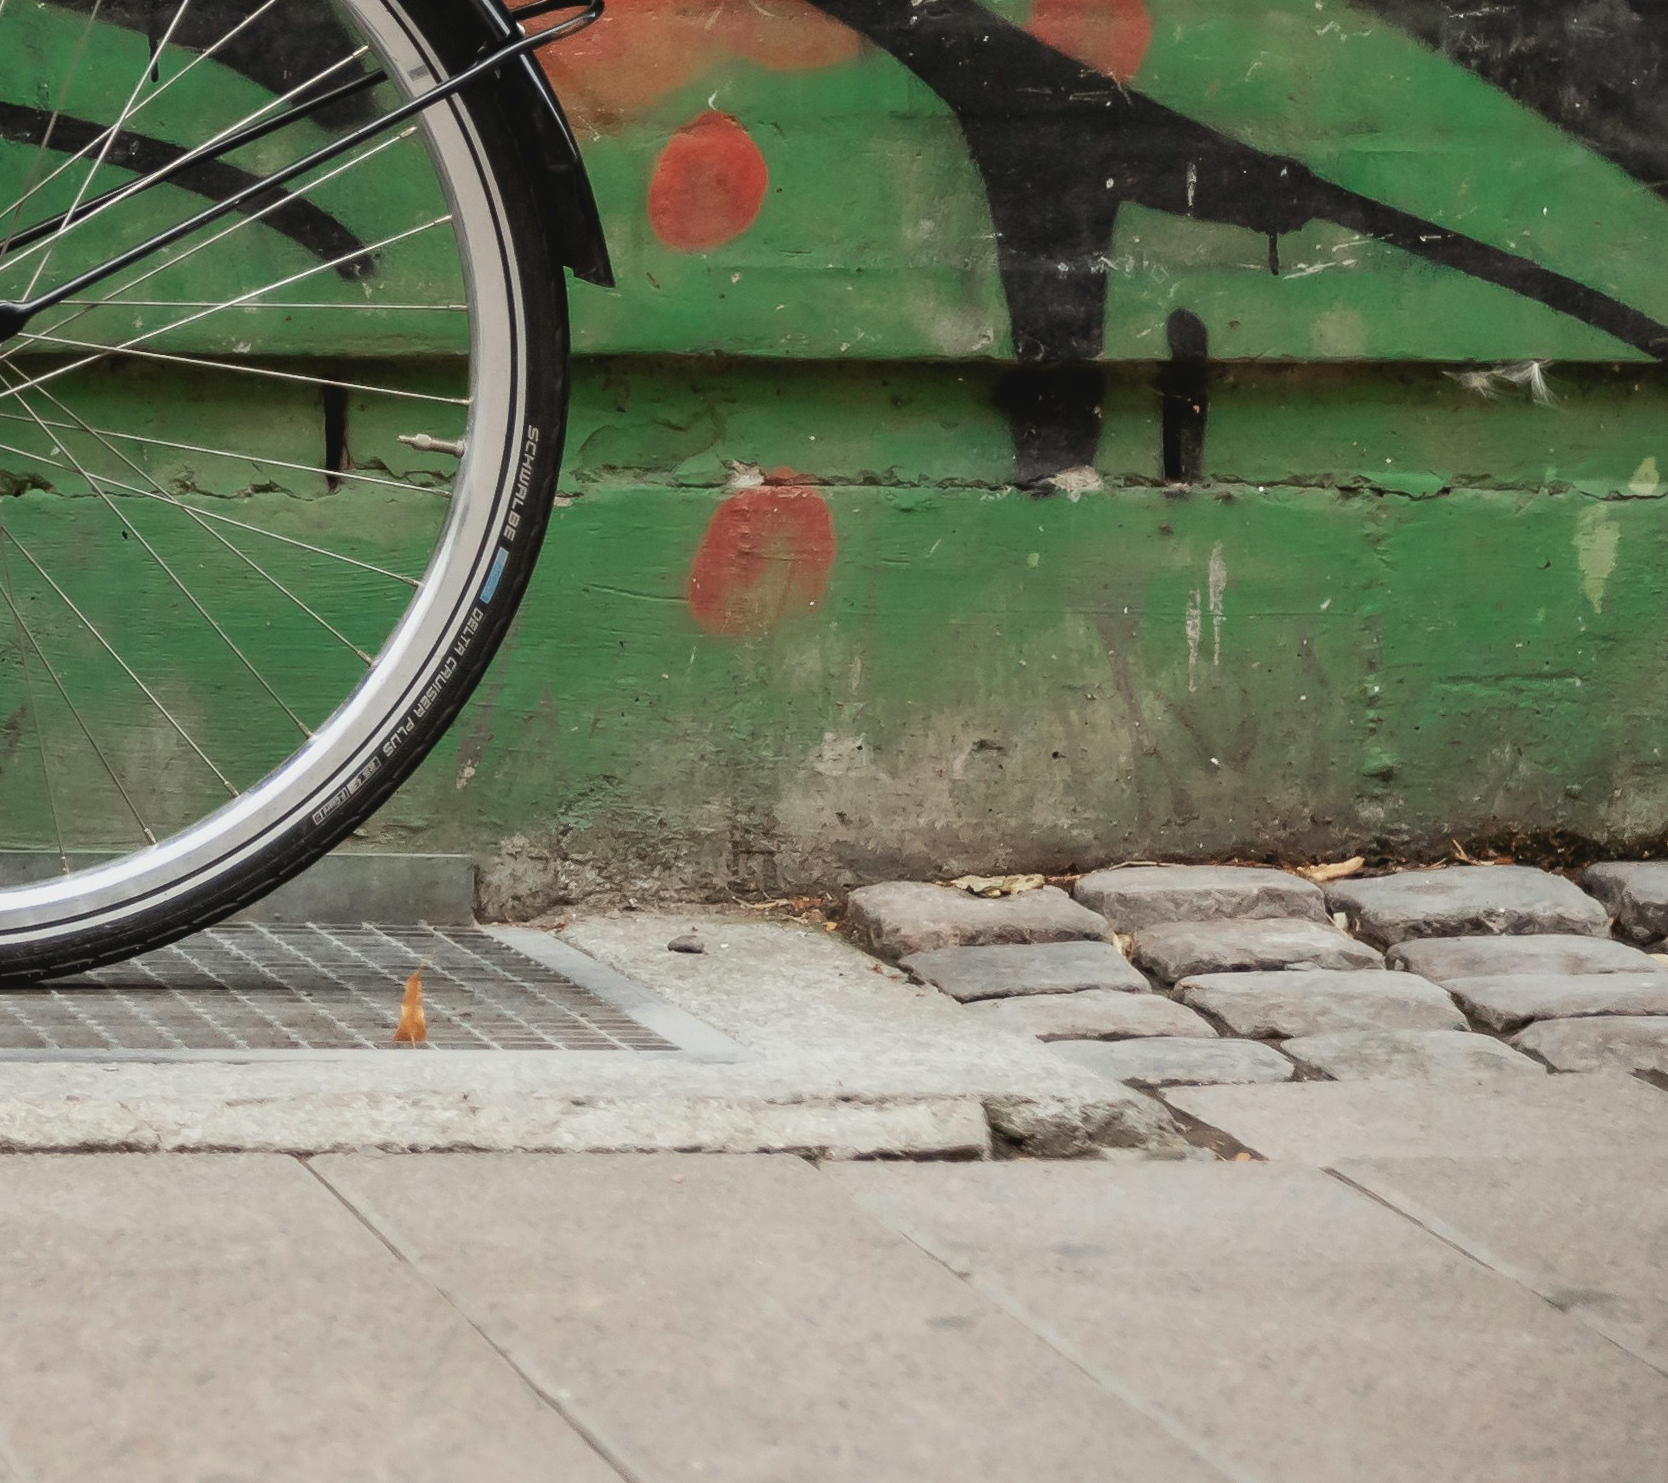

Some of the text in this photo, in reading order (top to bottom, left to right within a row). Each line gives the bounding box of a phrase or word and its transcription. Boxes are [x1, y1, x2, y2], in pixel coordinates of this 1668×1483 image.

[502, 424, 540, 542] SCHWALBE
[382, 606, 485, 757] DELTA CRUISER PLUS
